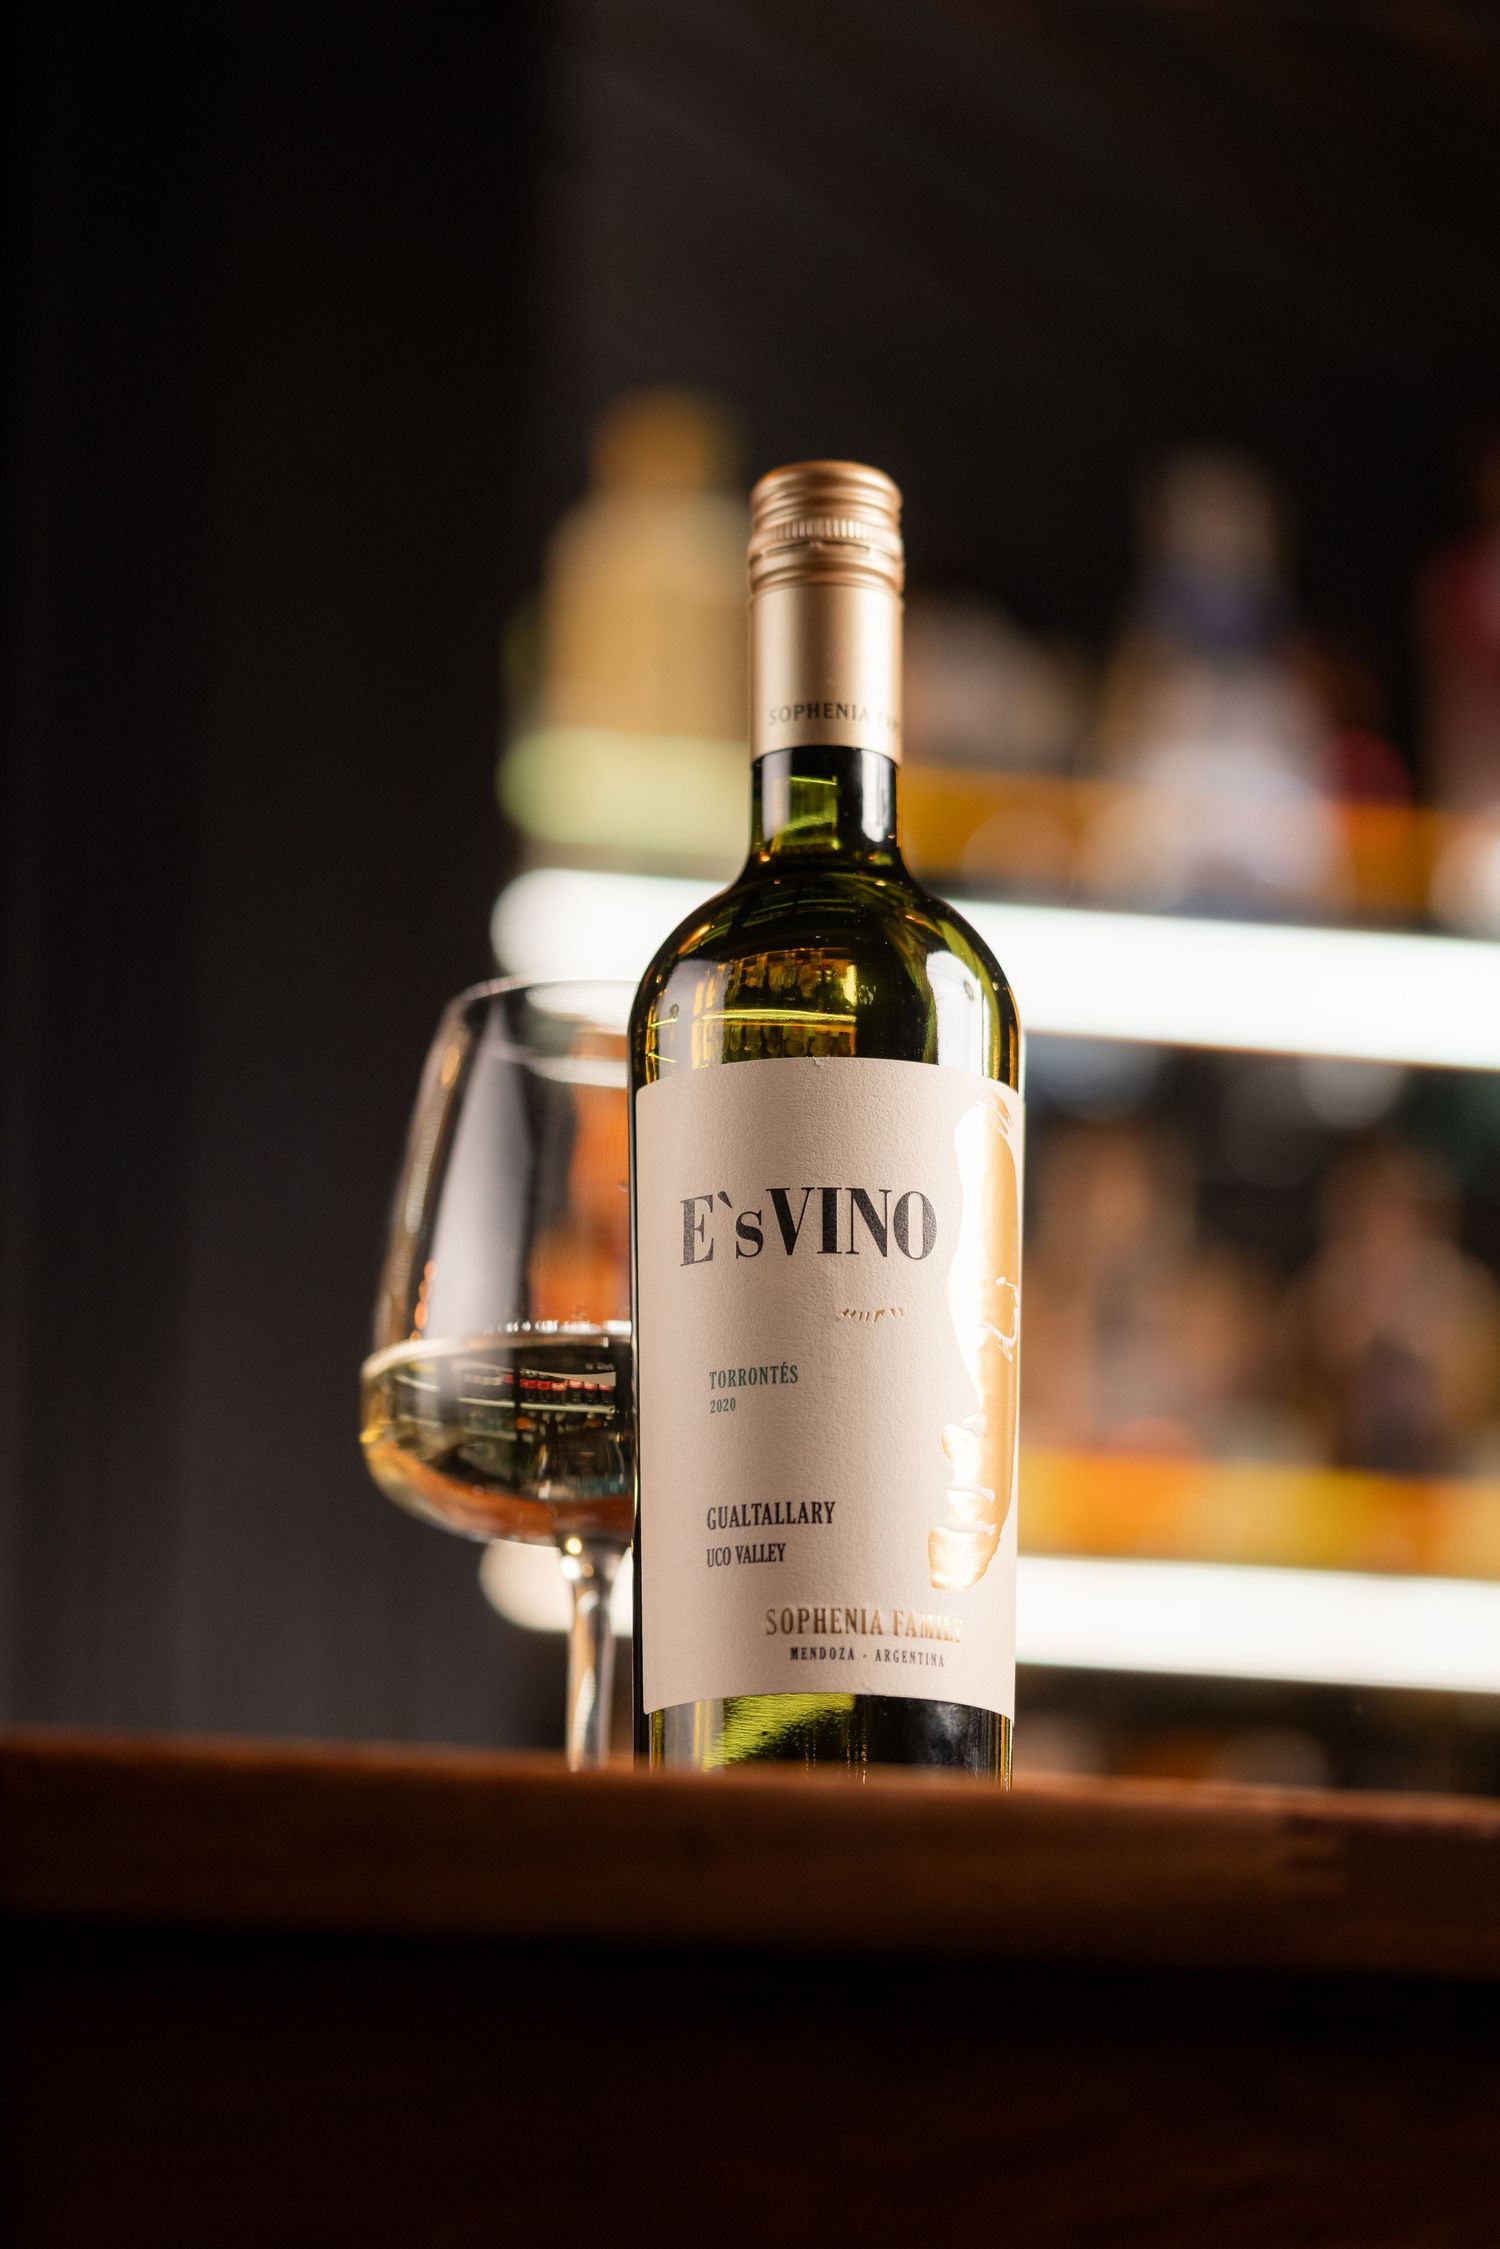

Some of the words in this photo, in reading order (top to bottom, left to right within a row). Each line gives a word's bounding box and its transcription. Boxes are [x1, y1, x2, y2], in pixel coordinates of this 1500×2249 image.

[768, 703, 868, 726] SOPHENIA
[709, 1362, 798, 1389] TORRONTÉS
[710, 1398, 736, 1413] 2020
[706, 1501, 835, 1530] GUALTALLARY
[706, 1547, 731, 1567] UCO
[735, 1543, 786, 1564] VALLEY
[766, 1608, 883, 1635] SOPHENIA
[893, 1611, 962, 1643] FAMILY
[790, 1647, 854, 1661] MENDOZA
[875, 1649, 944, 1668] ARGENTINA
